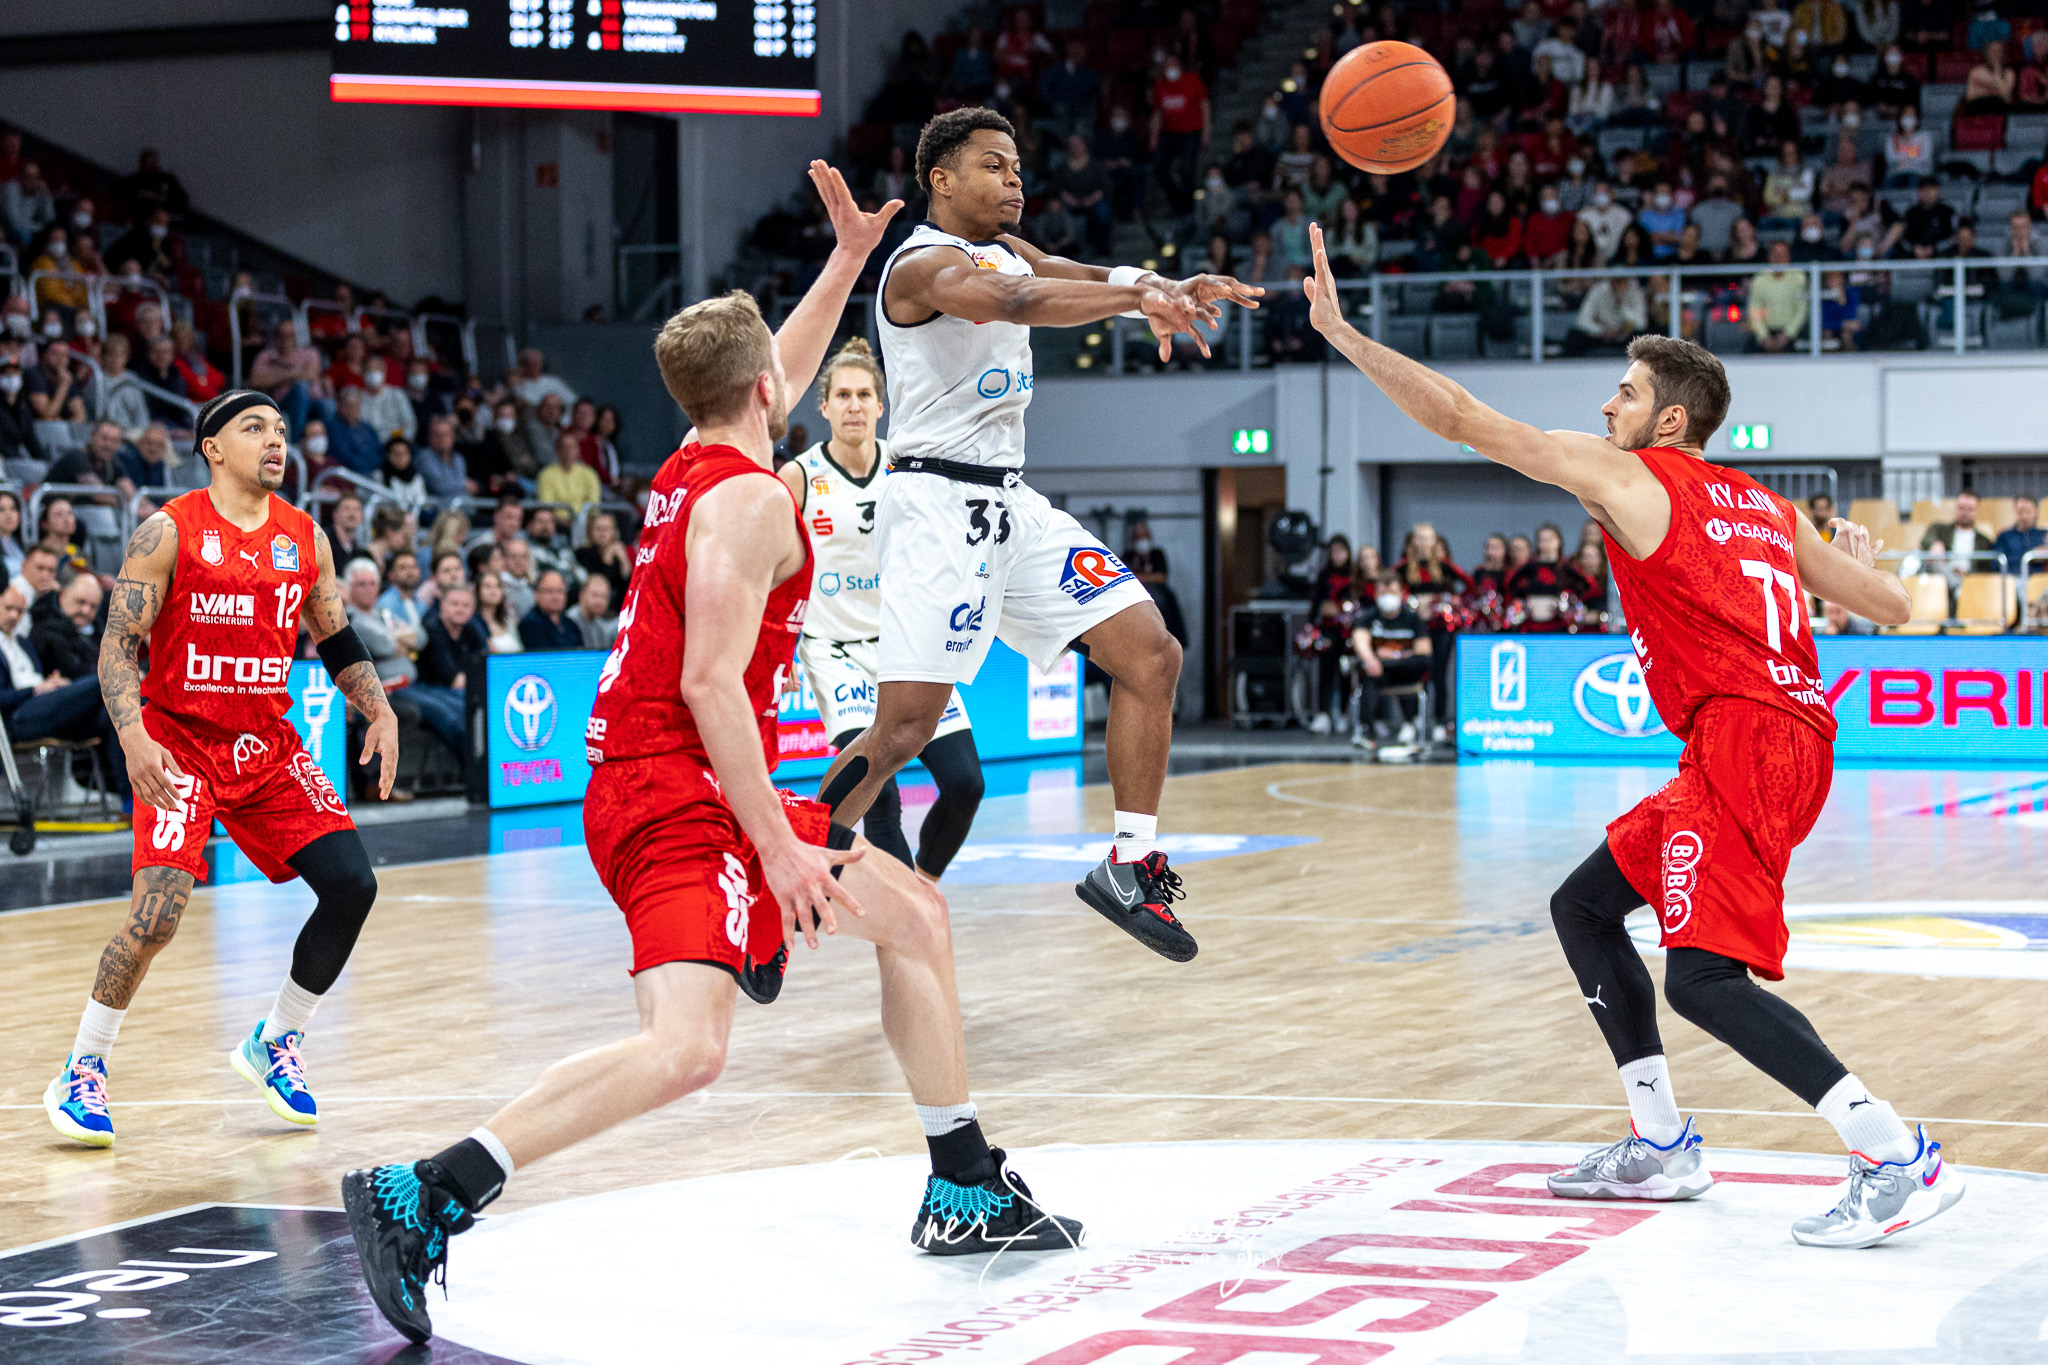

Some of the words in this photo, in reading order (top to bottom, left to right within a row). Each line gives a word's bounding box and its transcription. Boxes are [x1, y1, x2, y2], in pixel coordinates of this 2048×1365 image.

[965, 499, 1011, 546] 33
[1732, 522, 1795, 558] IGARASH
[190, 613, 254, 626] VERSICHERUNG
[191, 592, 235, 616] LVM
[275, 582, 303, 629] 12
[1739, 559, 1800, 654] 77
[183, 682, 235, 694] Excellence
[1823, 669, 2048, 727] YBRI
[501, 759, 563, 787] TOYOTA
